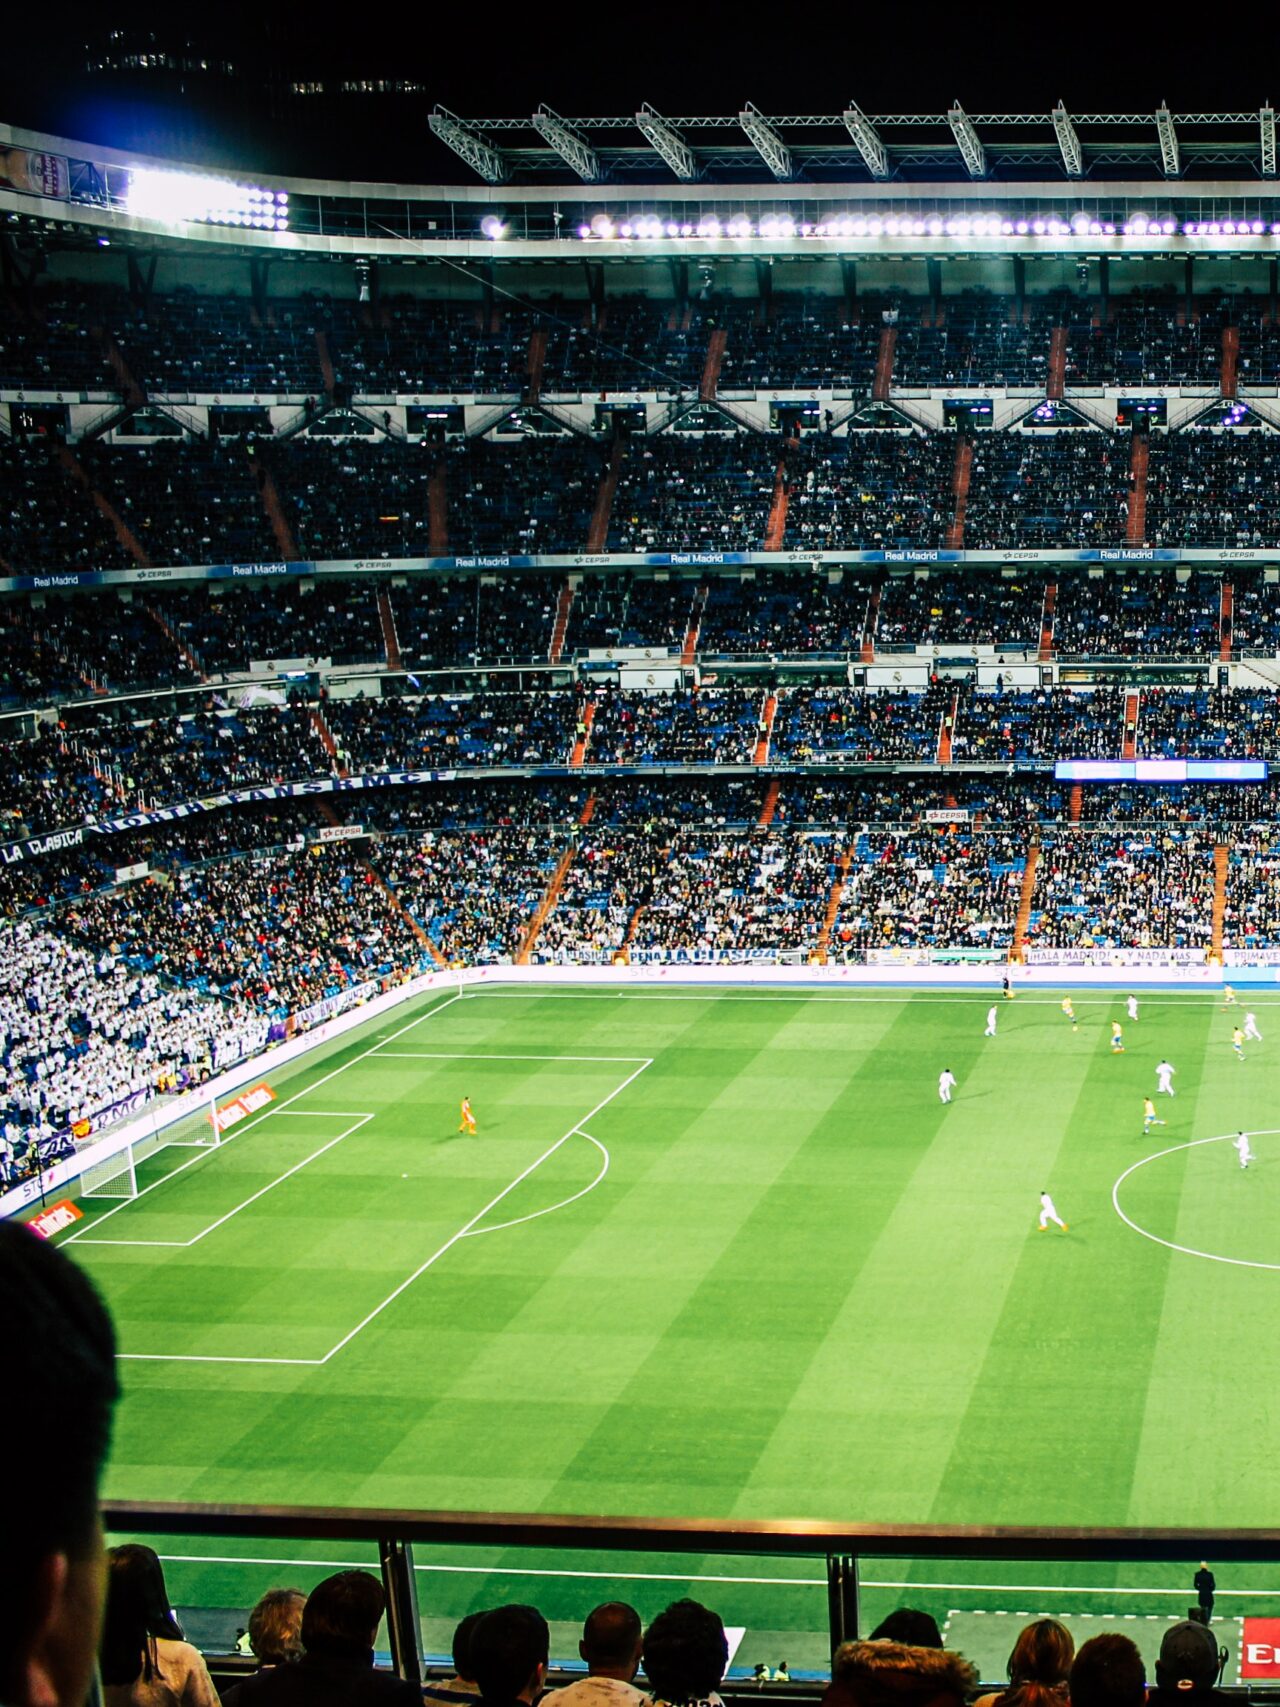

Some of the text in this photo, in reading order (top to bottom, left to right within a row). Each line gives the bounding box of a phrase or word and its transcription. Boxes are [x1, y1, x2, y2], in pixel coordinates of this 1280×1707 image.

[670, 554, 724, 563] Real Madrid
[885, 552, 938, 560] Real Madrid
[1100, 550, 1153, 559] Real Madrid
[456, 557, 509, 567] Real Madrid
[585, 556, 610, 564] CEPSA
[148, 570, 172, 578] CEPSA
[232, 564, 286, 576] Real Madrid
[34, 576, 78, 587] Real Madrid
[92, 801, 204, 834] NORTH
[940, 812, 966, 820] CEPSA
[334, 827, 361, 836] CEPSA
[3, 830, 83, 863] LA CLASICA
[566, 950, 608, 961] CLASICA
[1138, 952, 1166, 960] NADA
[30, 1206, 76, 1238] Emirates
